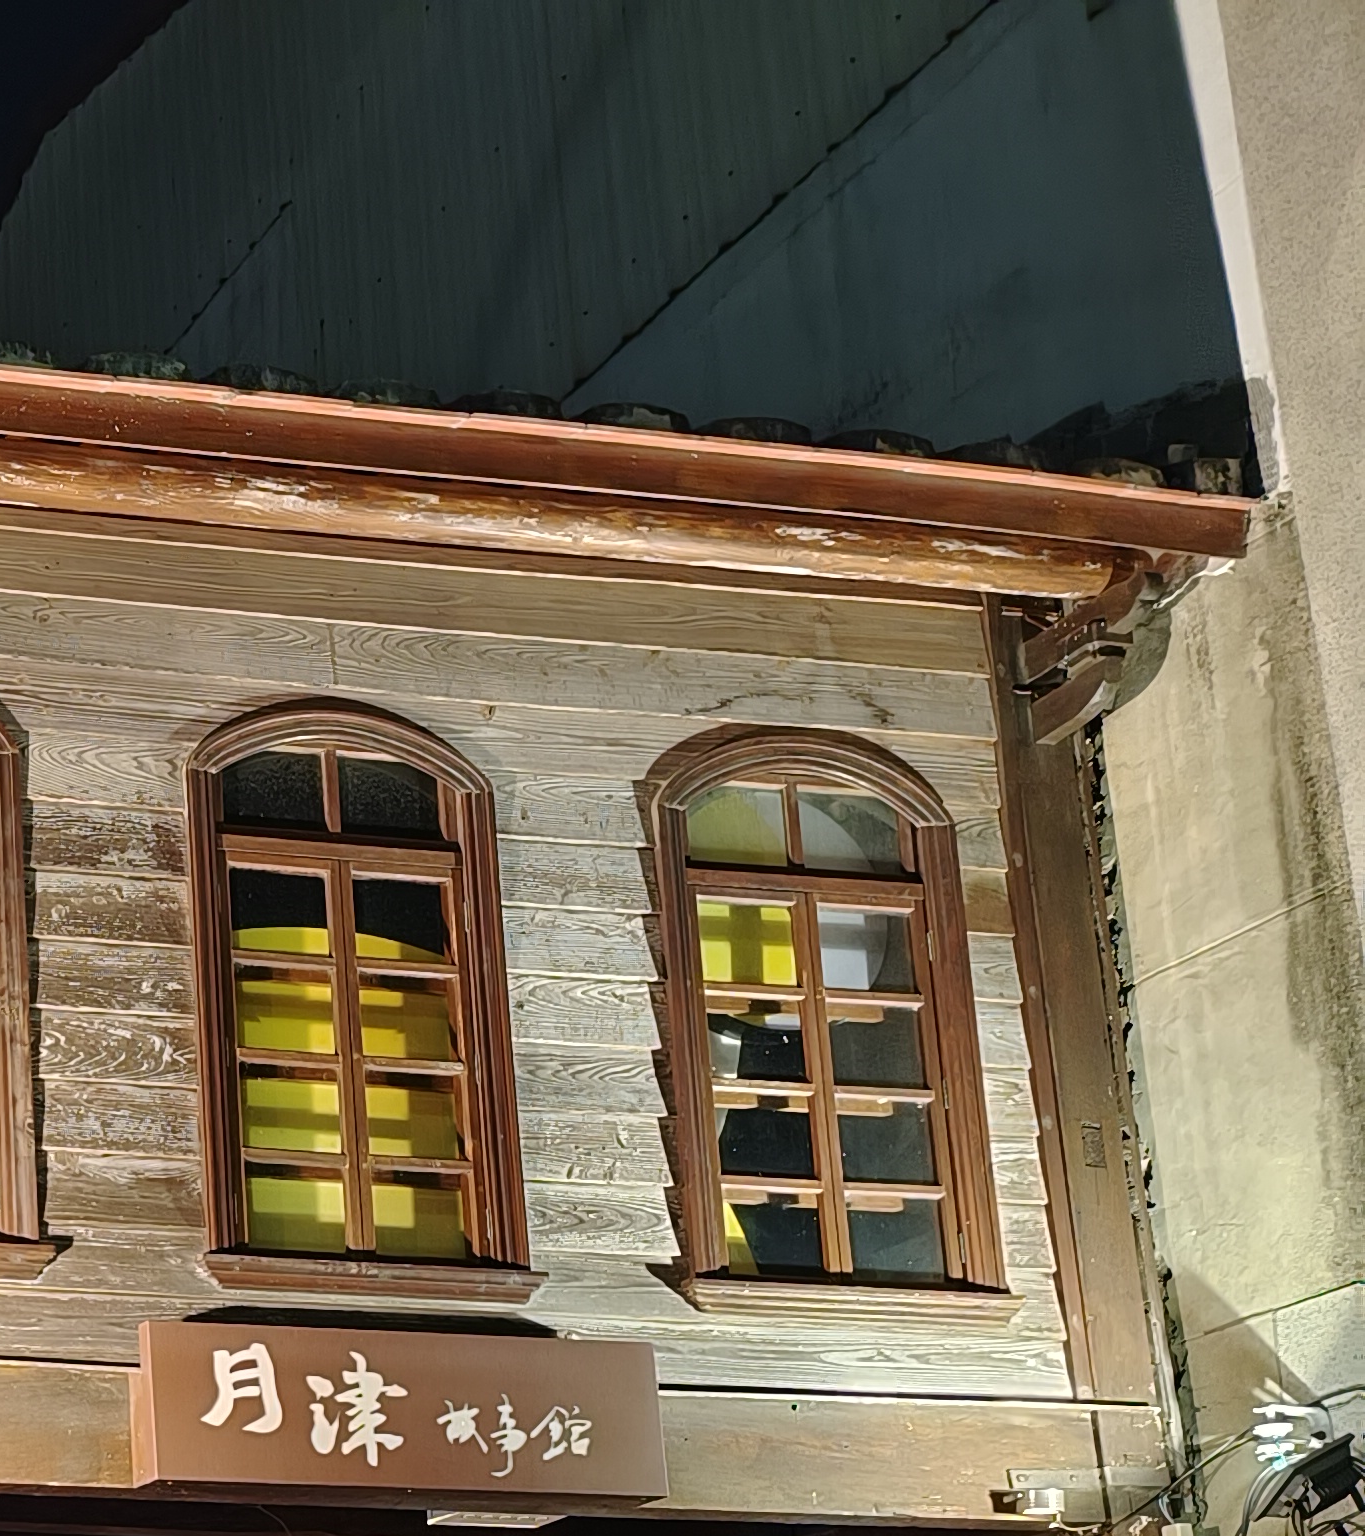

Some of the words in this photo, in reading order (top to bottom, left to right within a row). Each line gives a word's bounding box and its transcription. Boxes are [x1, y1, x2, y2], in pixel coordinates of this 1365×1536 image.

[200, 1342, 408, 1466] 月津
[437, 1394, 591, 1477] 故事館
